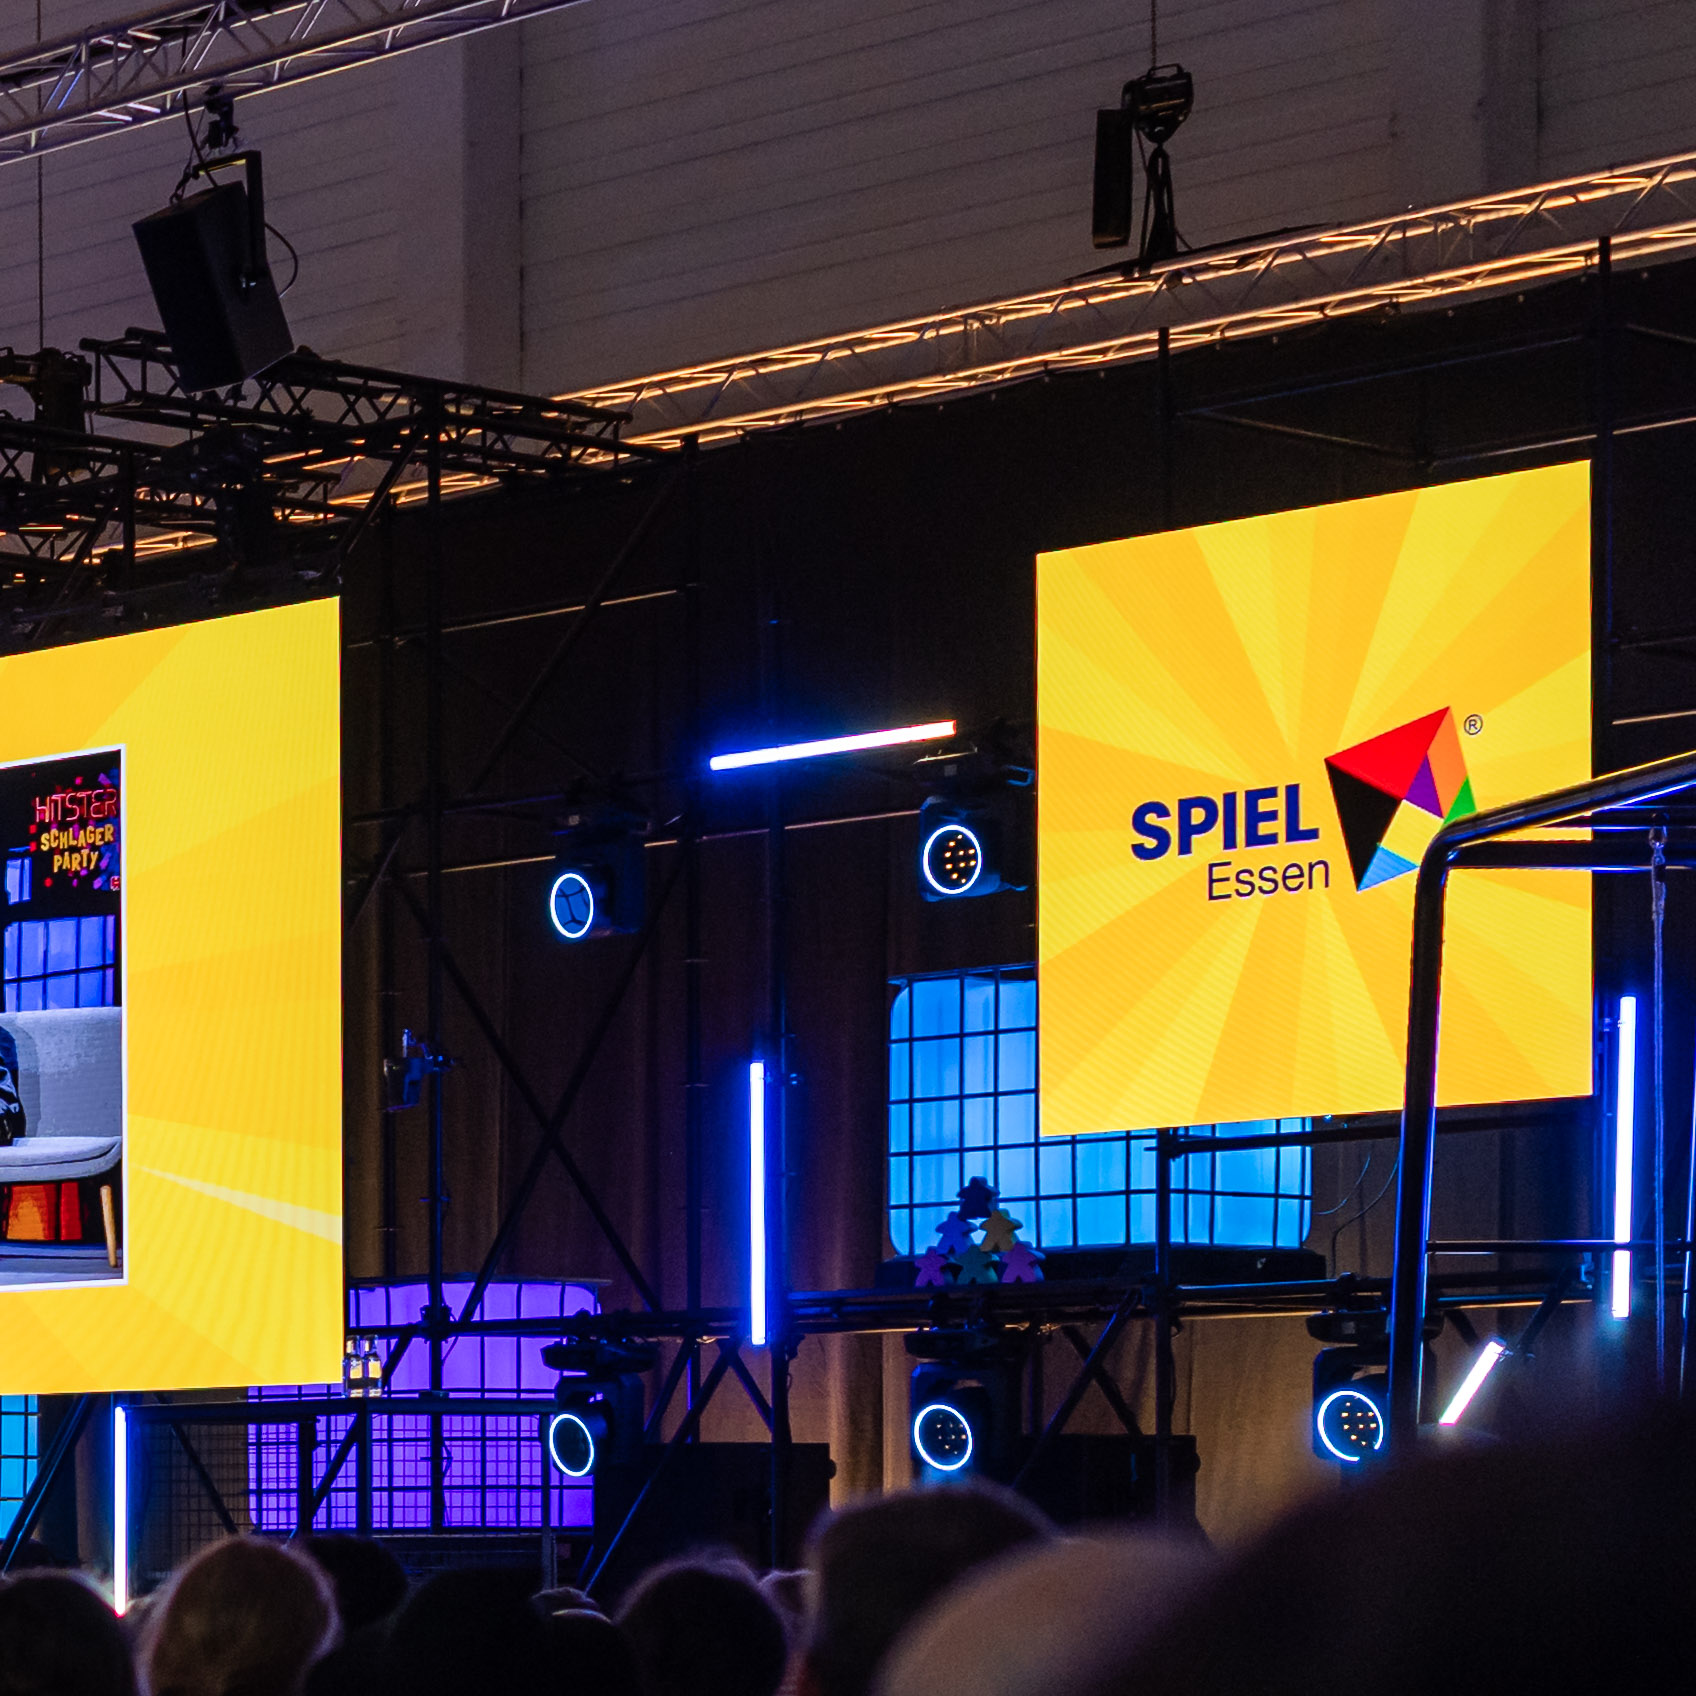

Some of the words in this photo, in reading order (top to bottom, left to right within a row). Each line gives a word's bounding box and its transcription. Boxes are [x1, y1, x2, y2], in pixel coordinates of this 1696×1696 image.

[35, 788, 117, 823] HITSTER
[1131, 783, 1320, 861] SPIEL
[40, 823, 114, 851] SCHLAGER
[53, 848, 99, 873] PARTY
[1208, 859, 1330, 901] Essen
